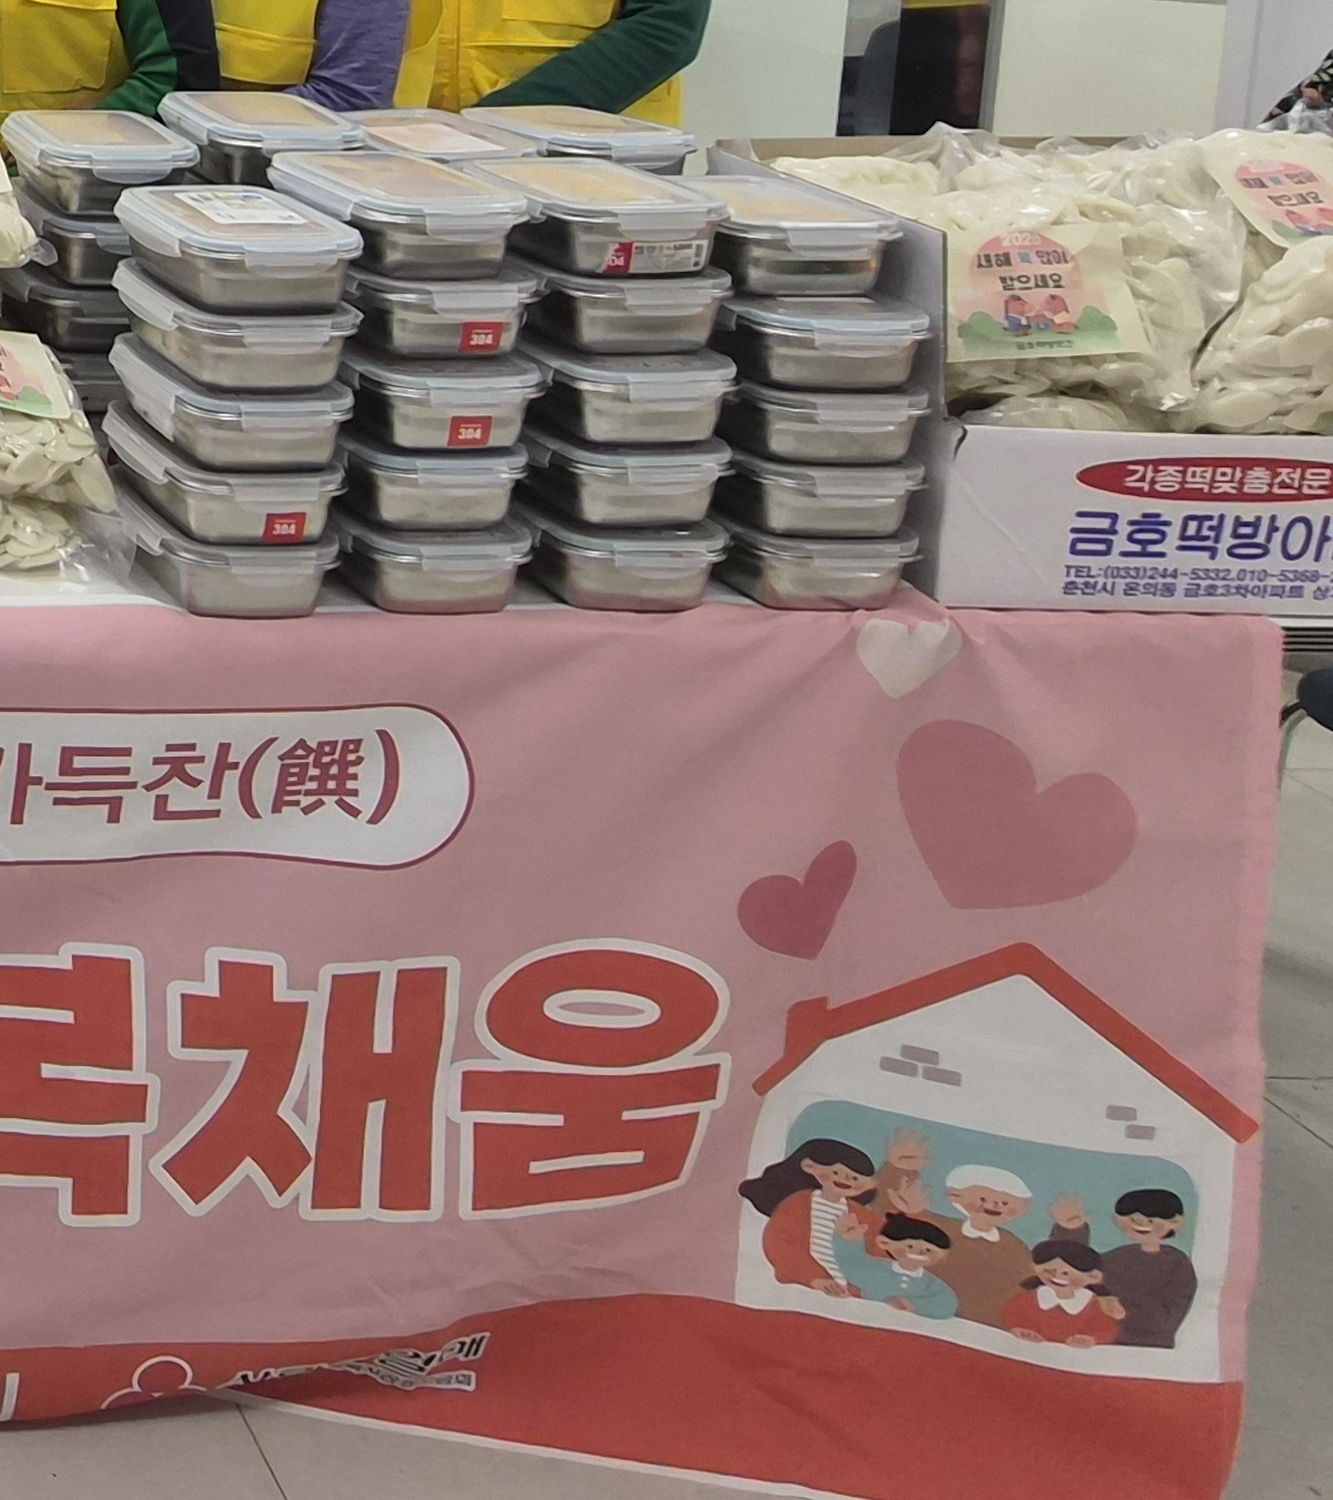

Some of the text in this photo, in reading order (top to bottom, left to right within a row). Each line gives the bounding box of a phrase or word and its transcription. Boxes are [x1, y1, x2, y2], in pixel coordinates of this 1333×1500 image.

[977, 252, 1012, 269] 새해
[1035, 249, 1070, 266] 많이
[998, 272, 1066, 291] 받으세요
[458, 427, 482, 440] 304
[1123, 464, 1332, 495] 각종떡맞춤전문
[272, 522, 297, 535] 304
[1068, 510, 1333, 563] 금호떡방아
[1062, 580, 1115, 596] 춘천시
